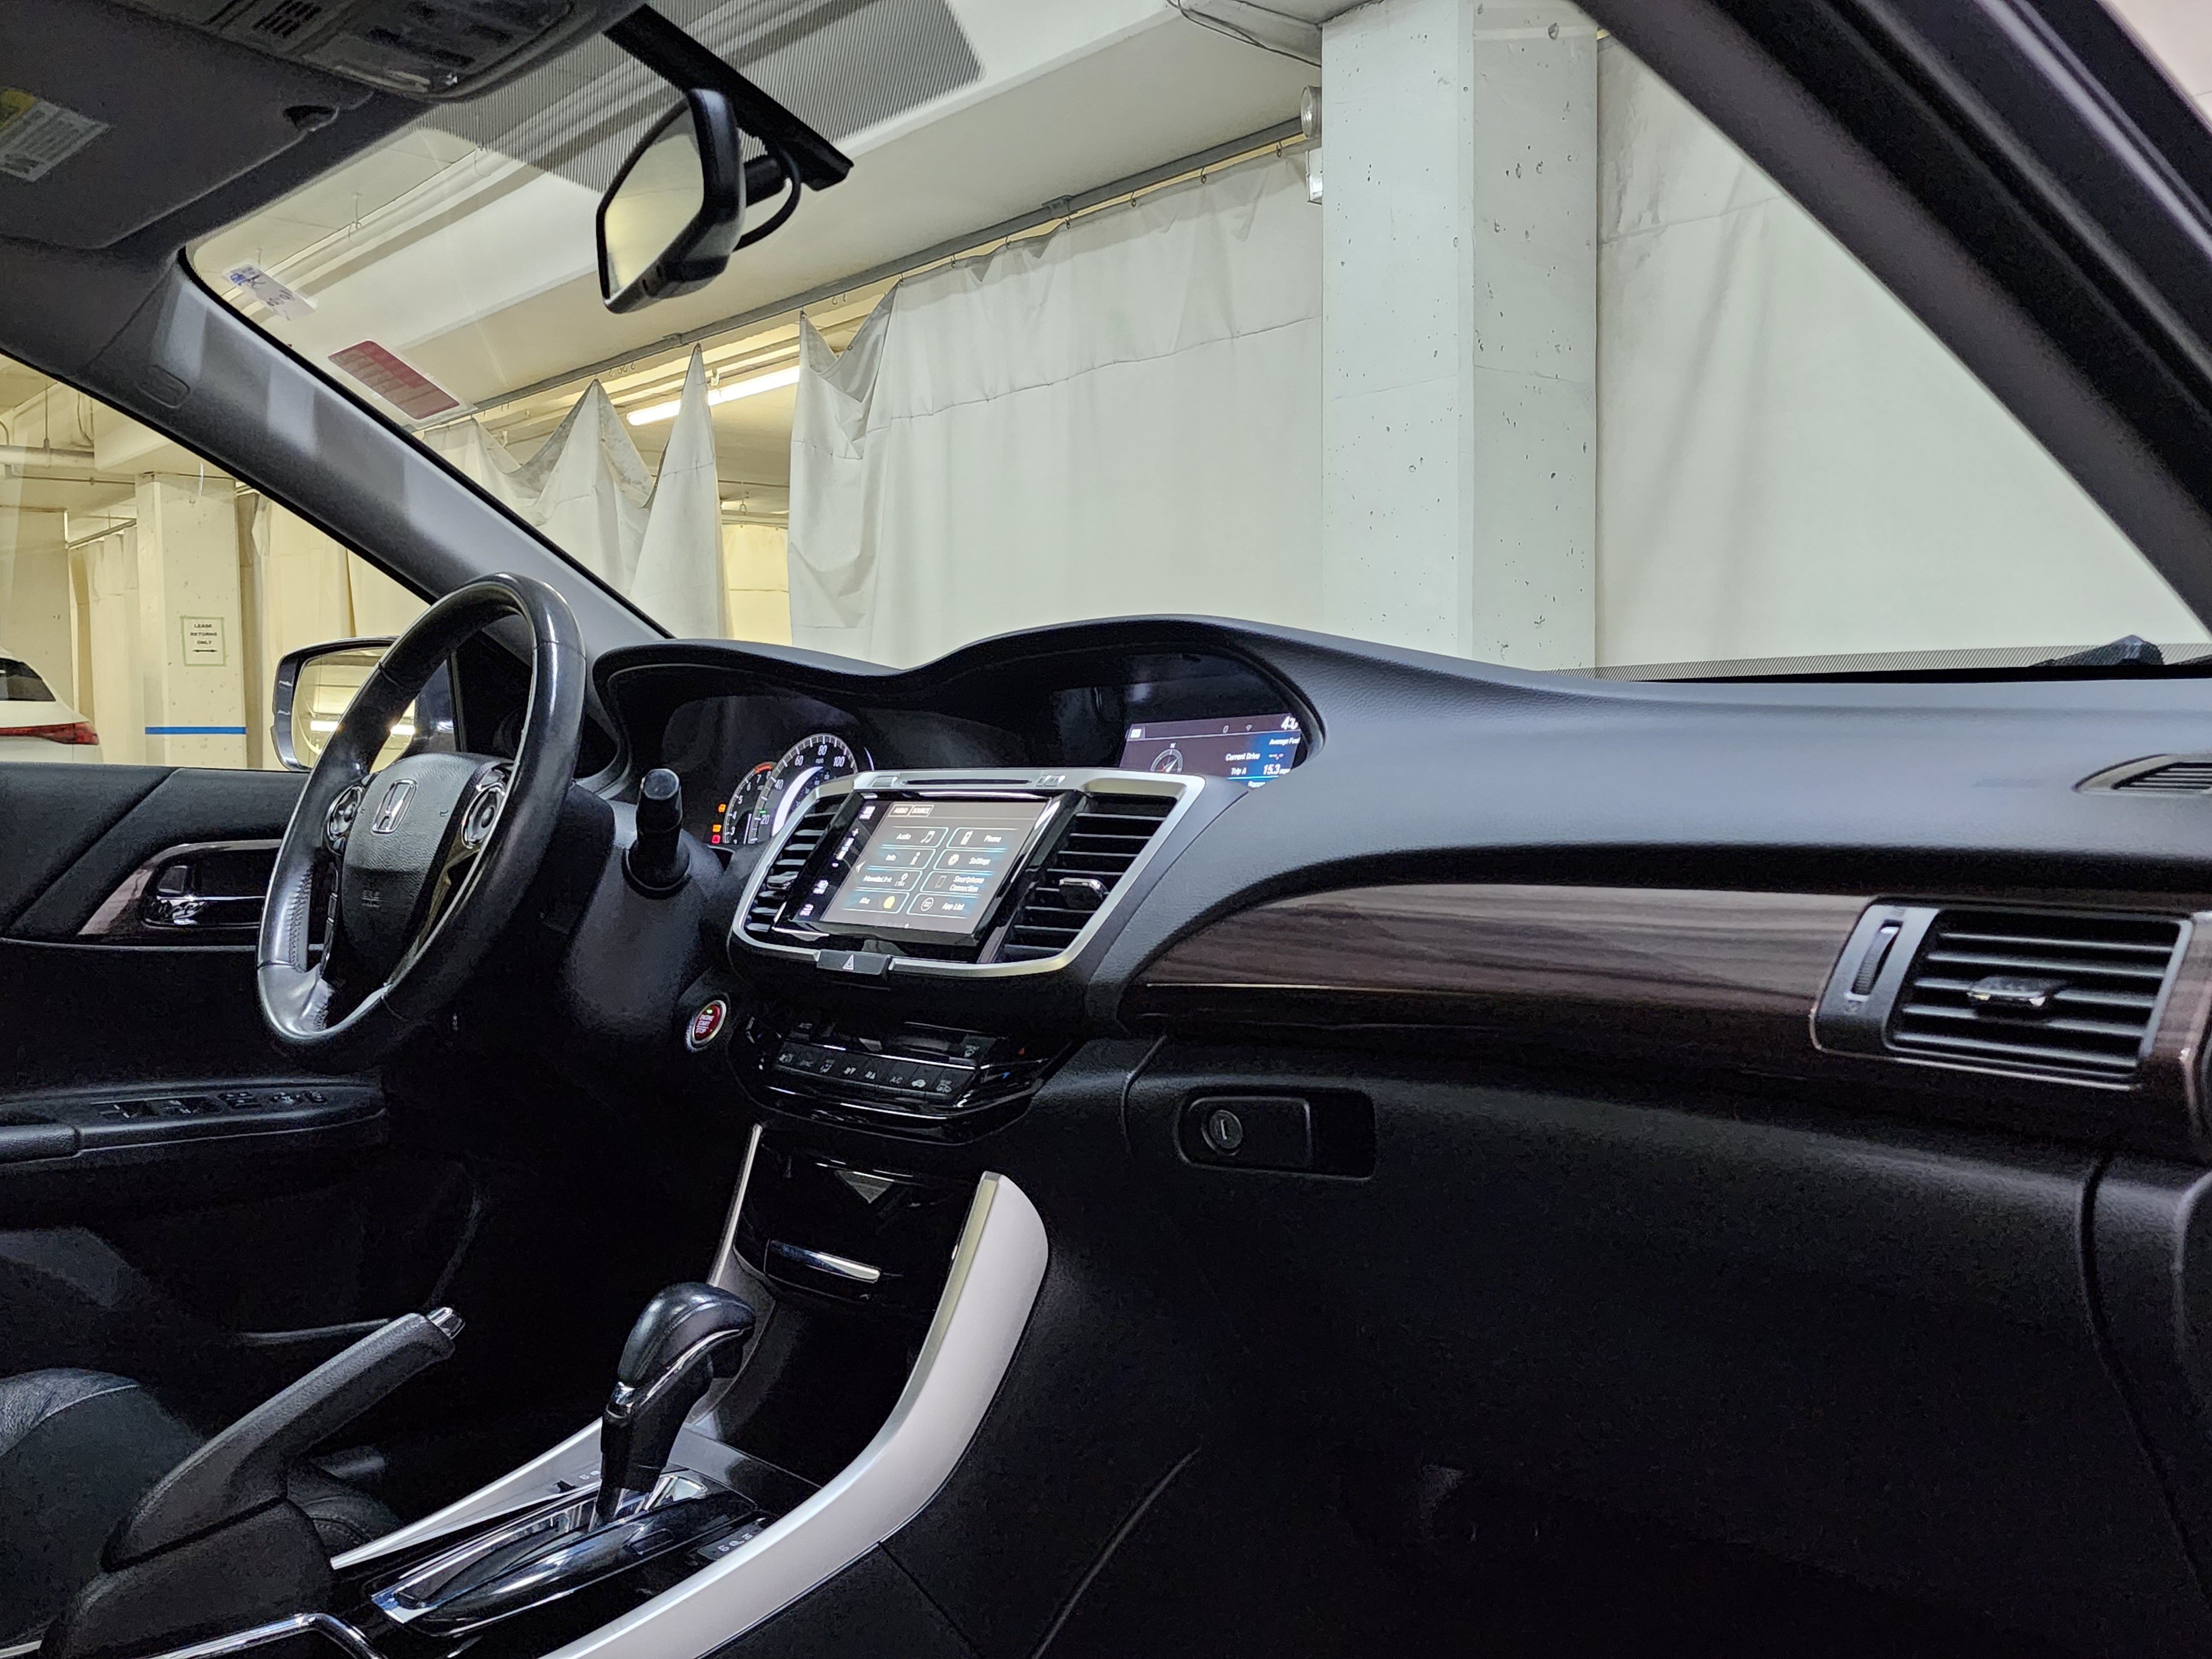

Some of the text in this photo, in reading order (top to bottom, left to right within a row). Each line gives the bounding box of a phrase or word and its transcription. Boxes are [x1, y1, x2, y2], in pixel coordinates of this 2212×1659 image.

[817, 744, 828, 756] 80
[794, 755, 804, 766] 60
[833, 755, 846, 768] 100
[1225, 753, 1245, 761] Current
[756, 774, 762, 784] 7
[746, 782, 752, 791] 6
[775, 779, 784, 790] 40
[737, 795, 743, 805] 5
[732, 811, 737, 820] 4
[760, 814, 770, 825] 20
[730, 826, 735, 836] 3
[969, 857, 991, 865] Settings
[953, 875, 985, 884] Smartphone
[949, 884, 979, 892] Connection
[941, 902, 965, 911] App List
